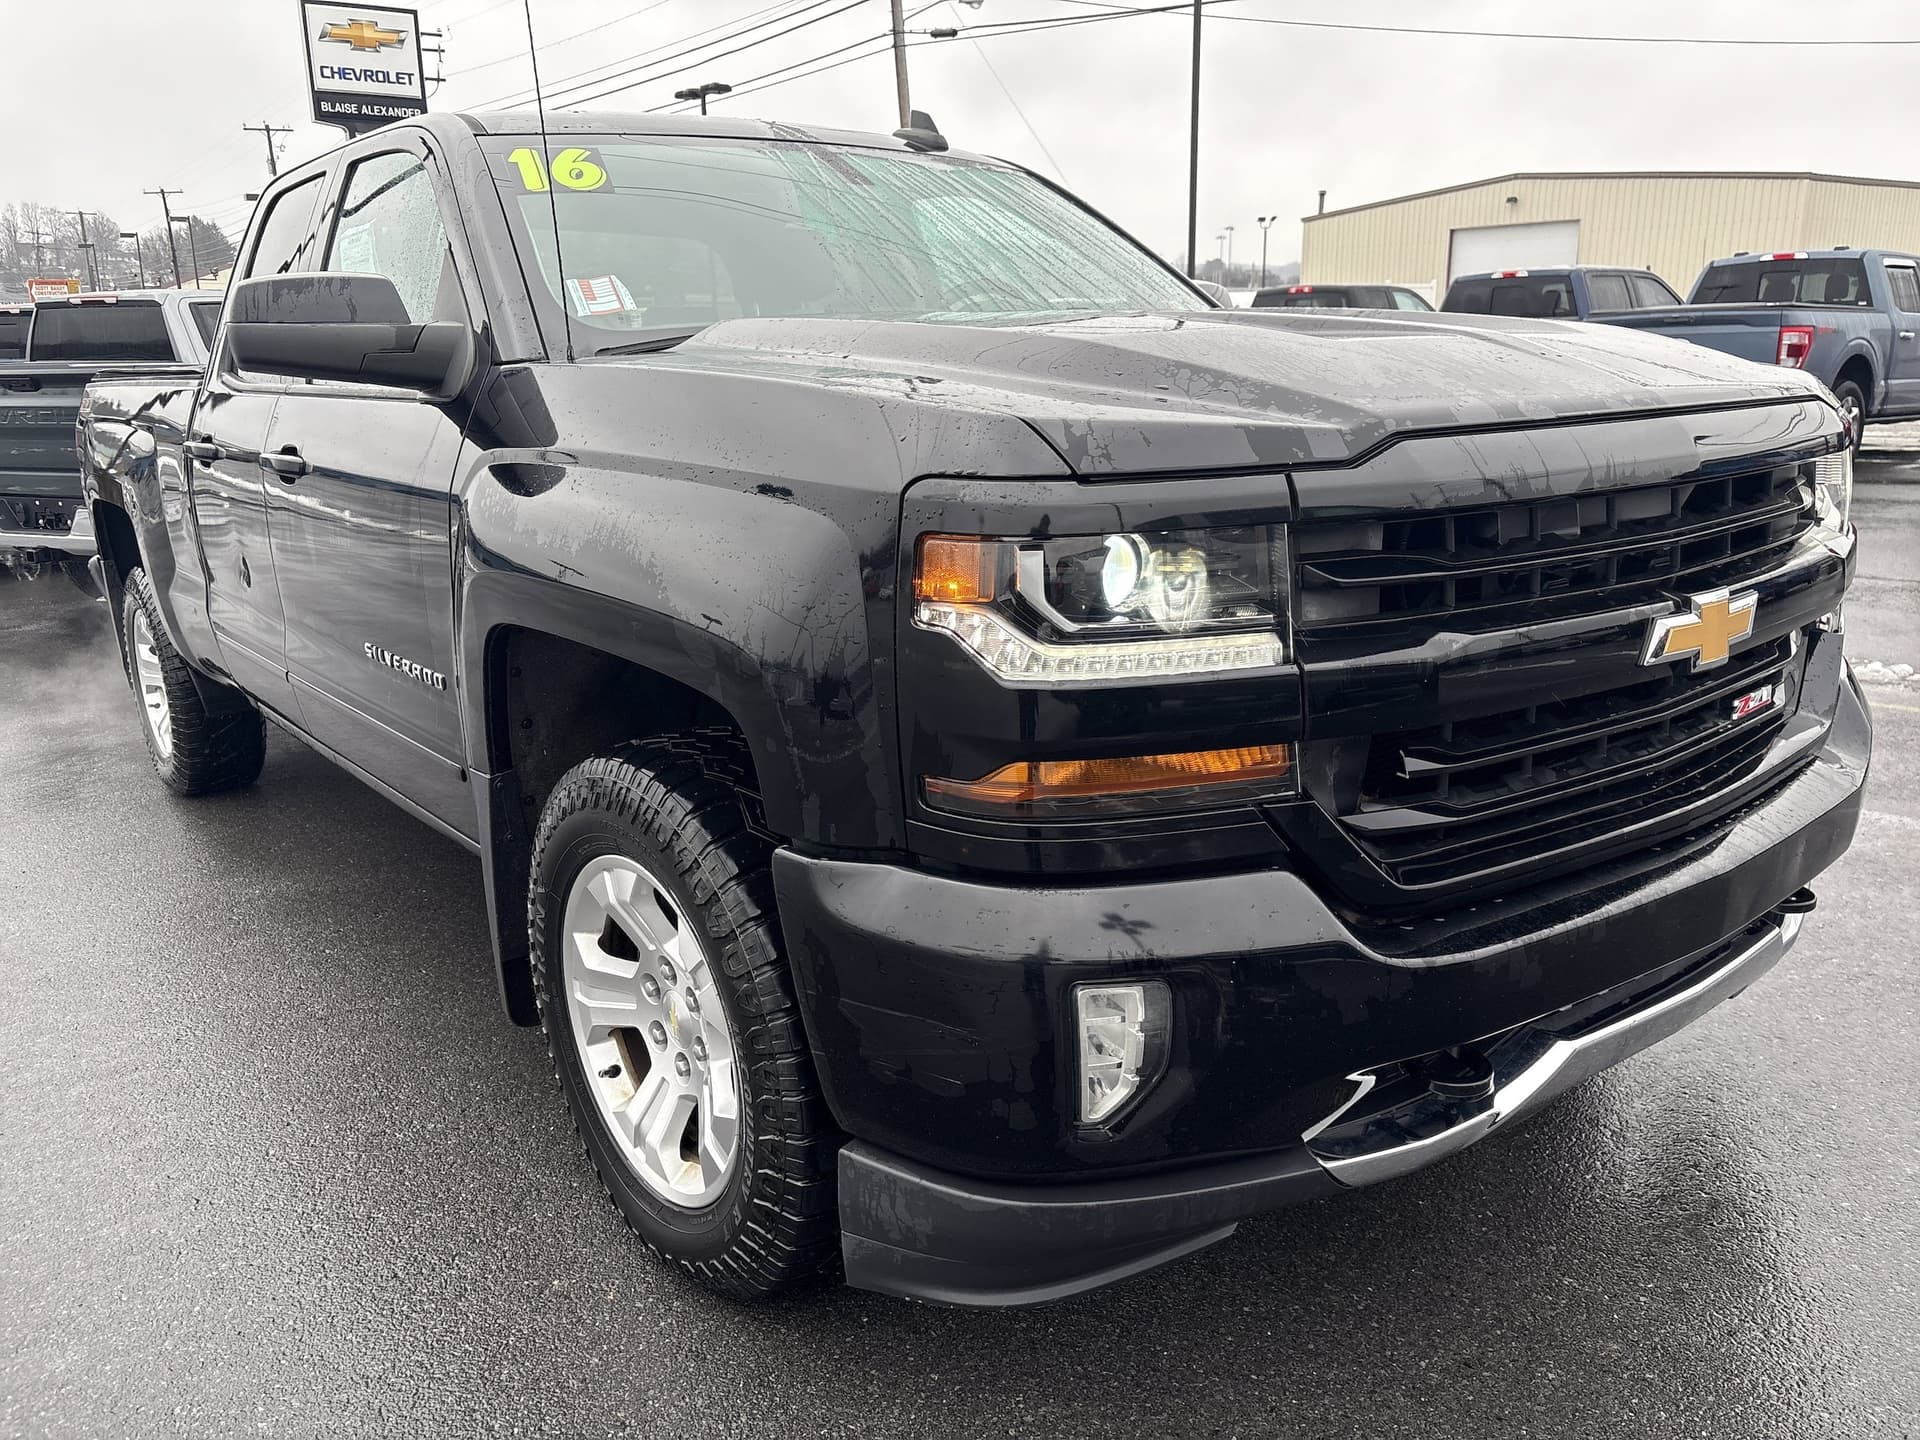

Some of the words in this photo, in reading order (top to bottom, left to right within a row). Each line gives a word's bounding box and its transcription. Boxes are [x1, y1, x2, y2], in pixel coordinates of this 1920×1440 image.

[319, 65, 415, 86] CHEVROLET
[320, 101, 359, 114] BLAISE
[361, 104, 421, 118] ALEXANDER
[507, 148, 607, 192] 16
[364, 642, 445, 690] SILVERADO
